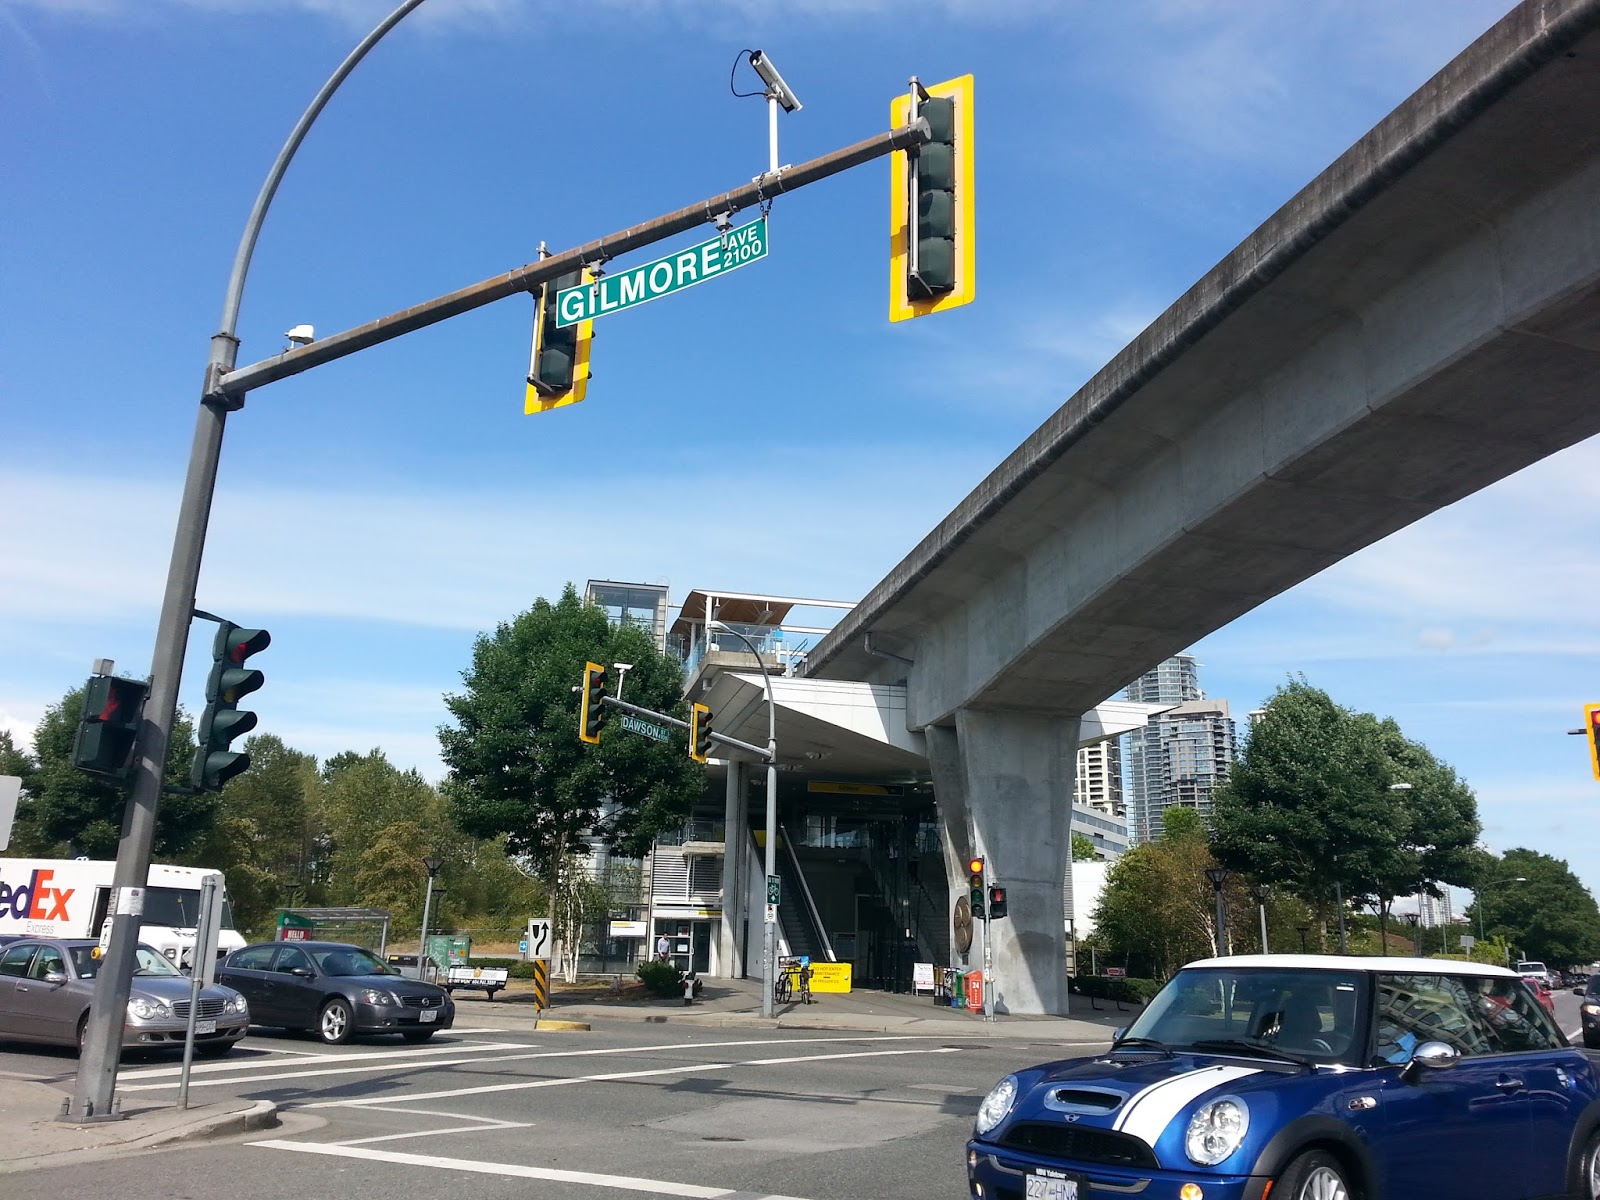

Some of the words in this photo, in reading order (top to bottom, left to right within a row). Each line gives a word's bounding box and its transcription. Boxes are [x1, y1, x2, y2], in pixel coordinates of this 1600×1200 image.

[561, 240, 721, 321] GILMORE
[728, 225, 758, 249] AVE
[724, 240, 762, 267] 2100
[622, 717, 659, 738] DAWSON
[0, 869, 75, 921] edEx
